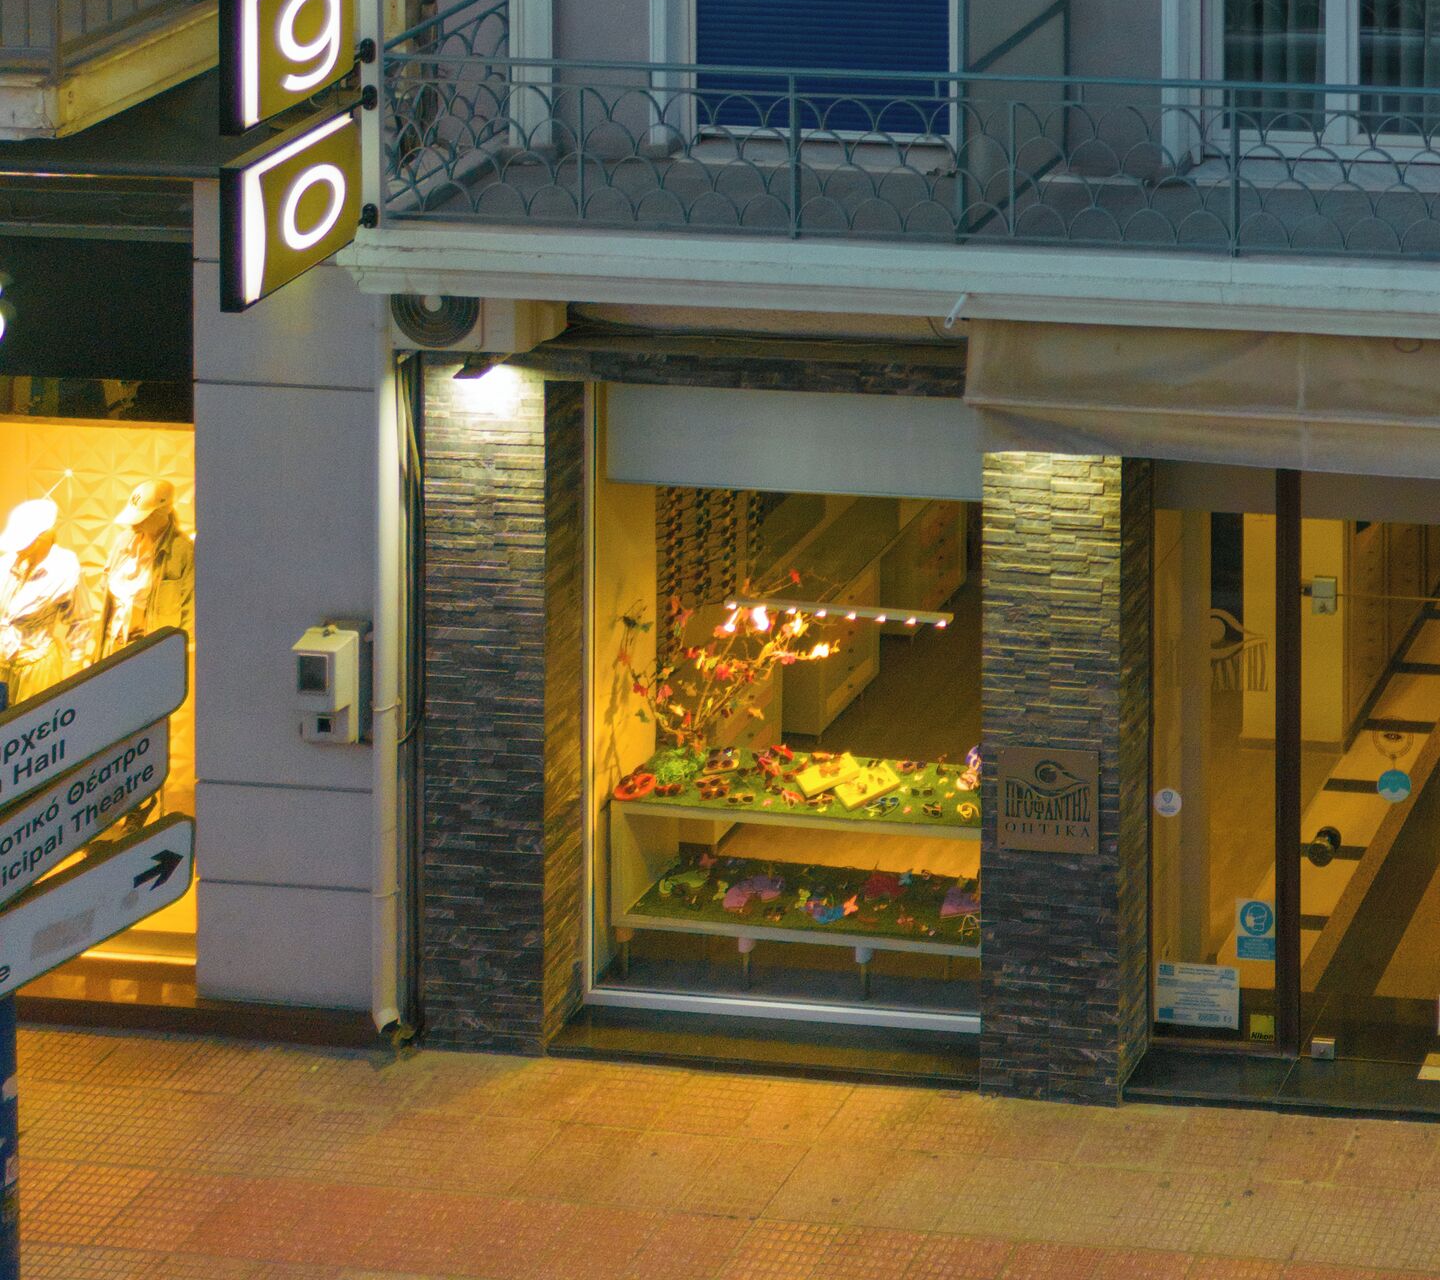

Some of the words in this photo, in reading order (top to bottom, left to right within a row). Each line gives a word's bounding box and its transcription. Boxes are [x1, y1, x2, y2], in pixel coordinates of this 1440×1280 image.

[0, 707, 76, 765] ρχείο
[13, 739, 65, 785] Hall
[67, 738, 150, 805] Θέατρο
[1005, 781, 1090, 823] ΠΡΟΦΑΝΤΗΣ
[2, 827, 63, 887] icipal
[70, 764, 154, 832] Theatre
[1005, 821, 1090, 838] ΟΠΤΙΚΑ
[1251, 1032, 1274, 1040] Nikon
